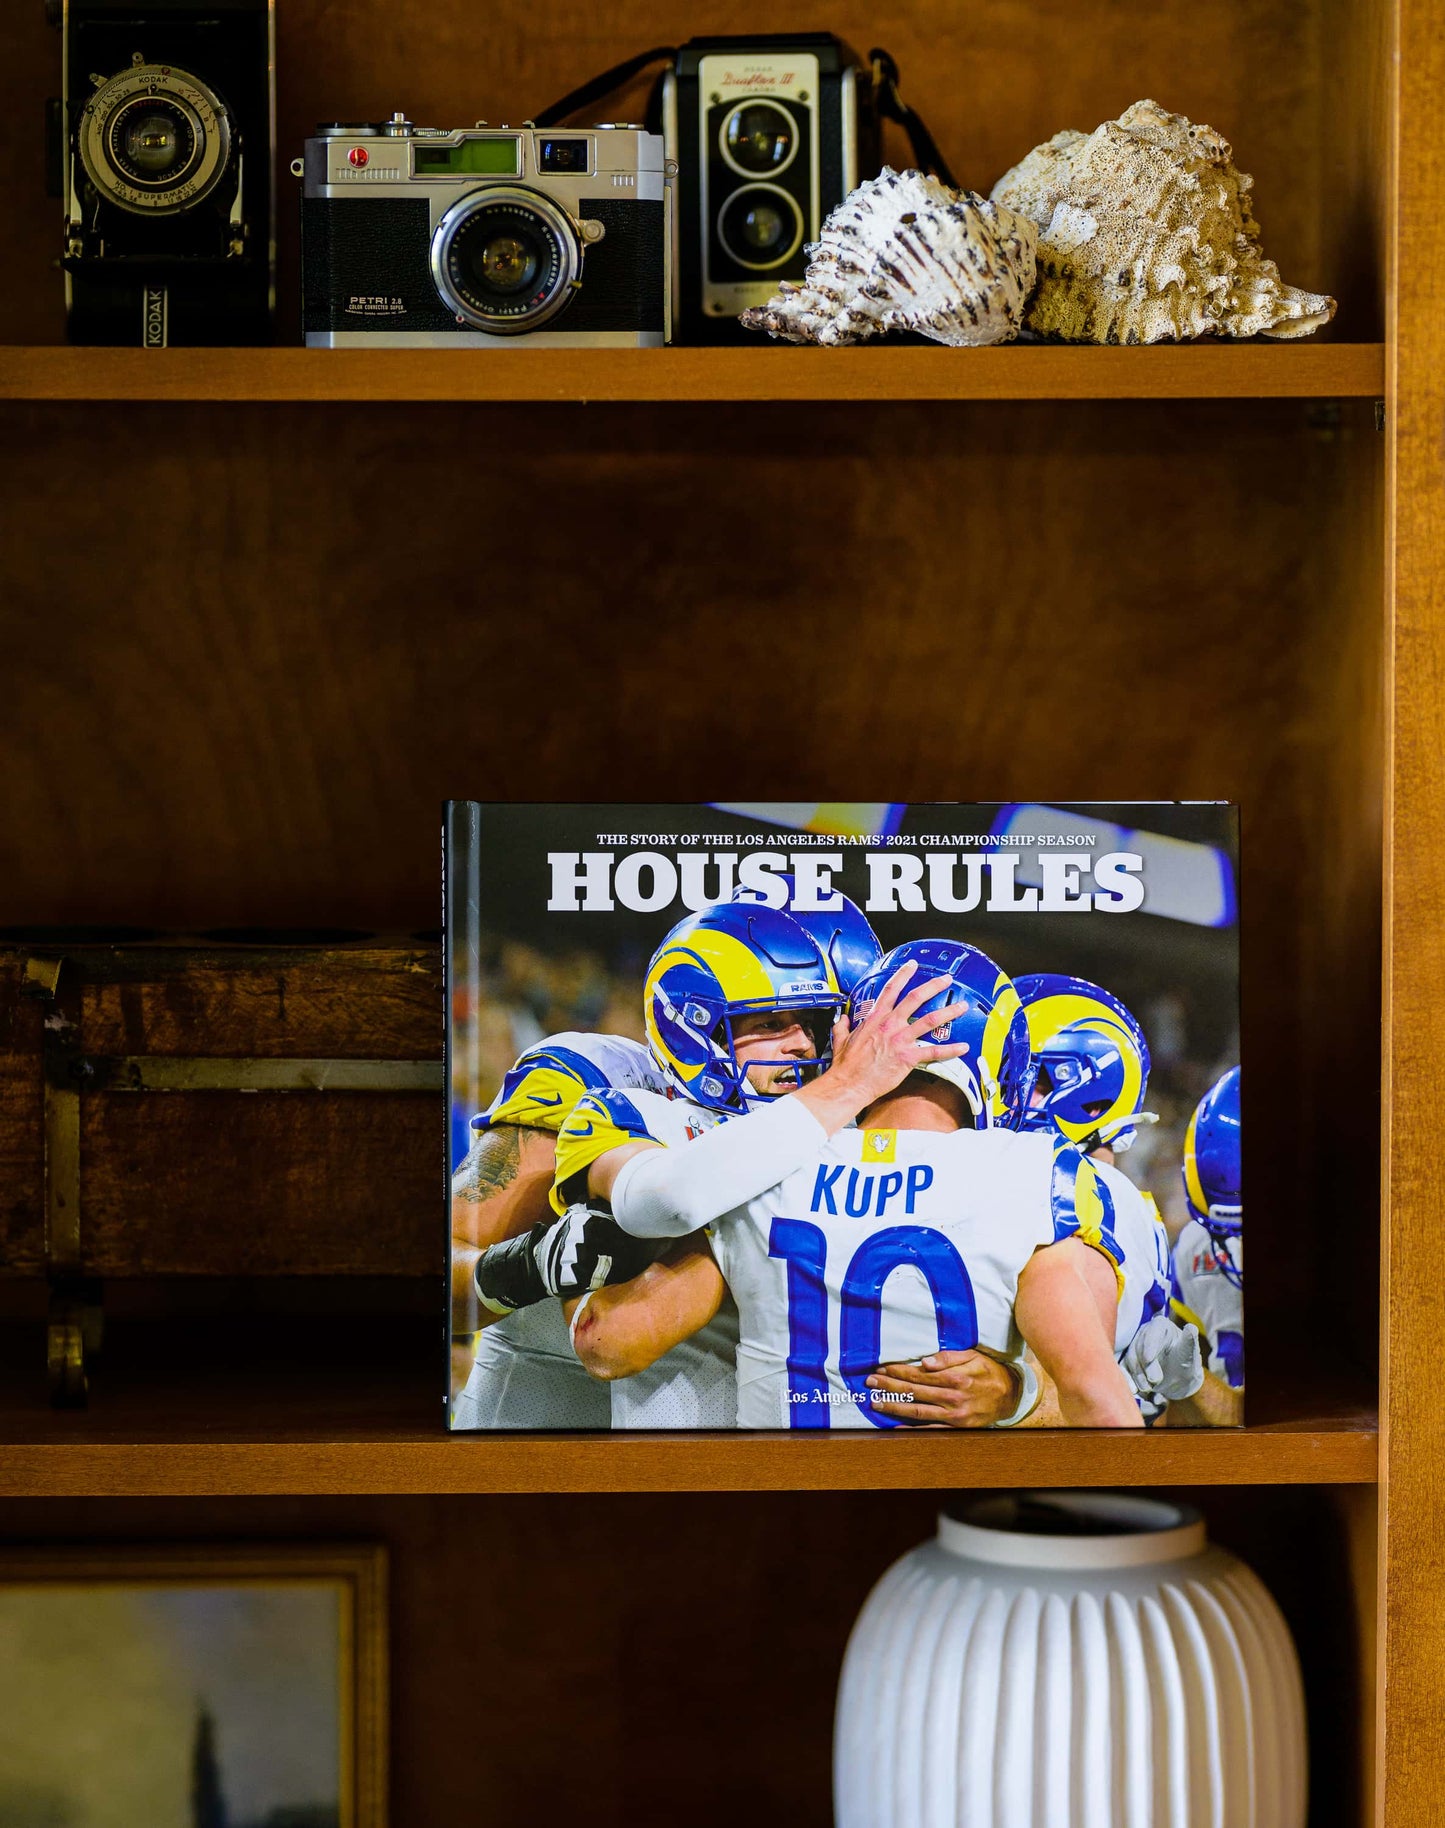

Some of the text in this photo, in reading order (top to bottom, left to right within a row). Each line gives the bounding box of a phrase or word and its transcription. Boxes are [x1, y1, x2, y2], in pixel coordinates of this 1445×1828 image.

[138, 76, 168, 84] KODAK
[138, 181, 195, 200] SUPERMATIC
[350, 296, 388, 304] PETRI
[148, 290, 162, 344] KODAK
[596, 834, 628, 846] THE
[630, 834, 679, 846] STORY
[680, 834, 701, 846] OF
[702, 834, 734, 846] THE
[735, 834, 764, 846] LOS
[765, 834, 835, 846] ANGELES
[886, 834, 918, 846] 2021
[919, 834, 1036, 846] CHAMPIONSHIP
[1037, 834, 1097, 846] SEASON
[547, 851, 1145, 913] HOUSE RULES
[790, 982, 824, 992] RAMS
[934, 1027, 949, 1039] NFL
[810, 1163, 934, 1218] KUPP
[768, 1217, 979, 1428] 10
[784, 1388, 914, 1405] Los Angeles Times
